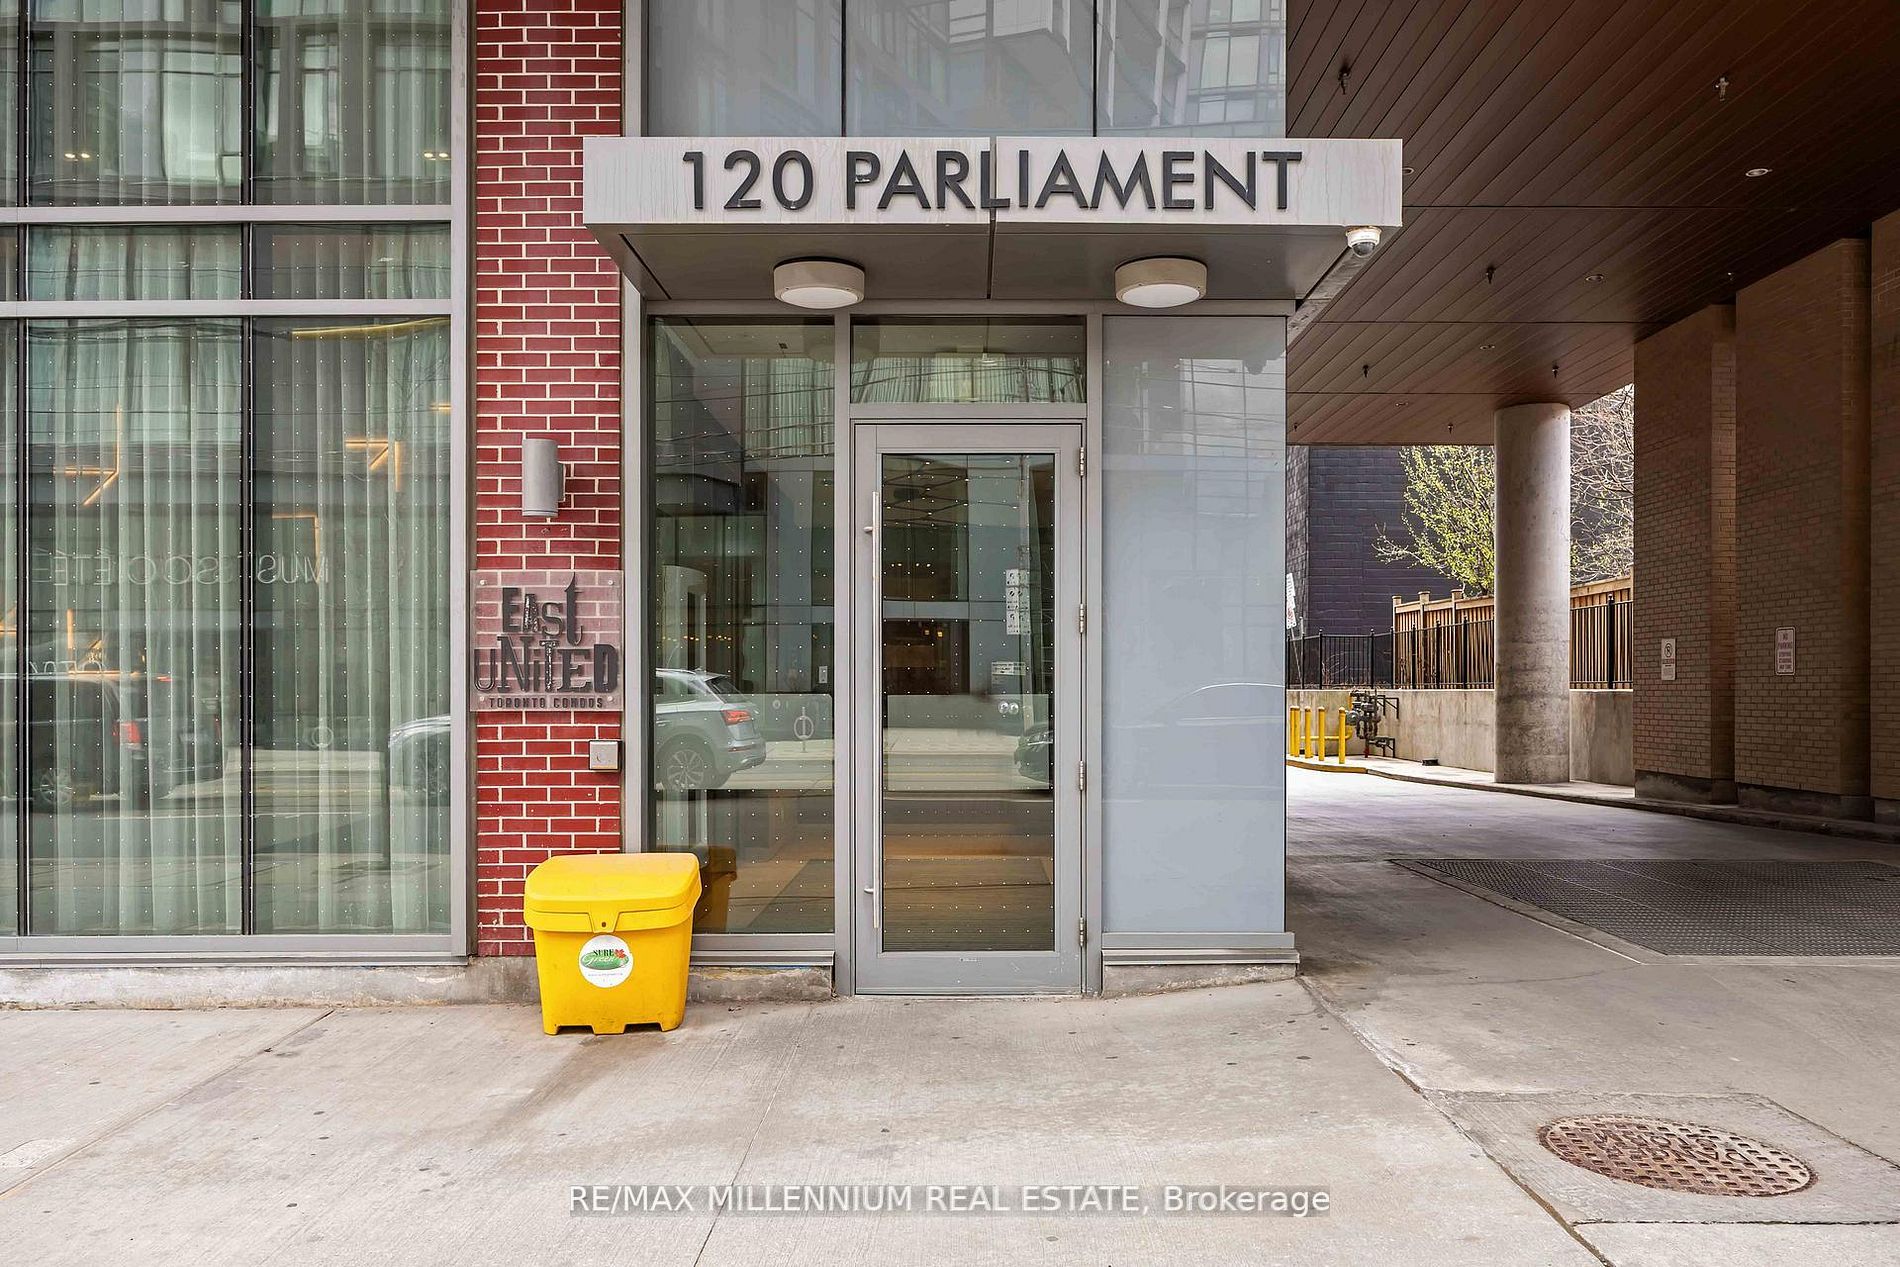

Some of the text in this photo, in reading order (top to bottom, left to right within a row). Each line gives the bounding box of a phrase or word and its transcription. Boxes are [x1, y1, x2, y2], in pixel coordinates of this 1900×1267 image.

[683, 149, 1302, 210] 120 PARLIAMENT
[489, 697, 603, 709] TORONTO CONDOS
